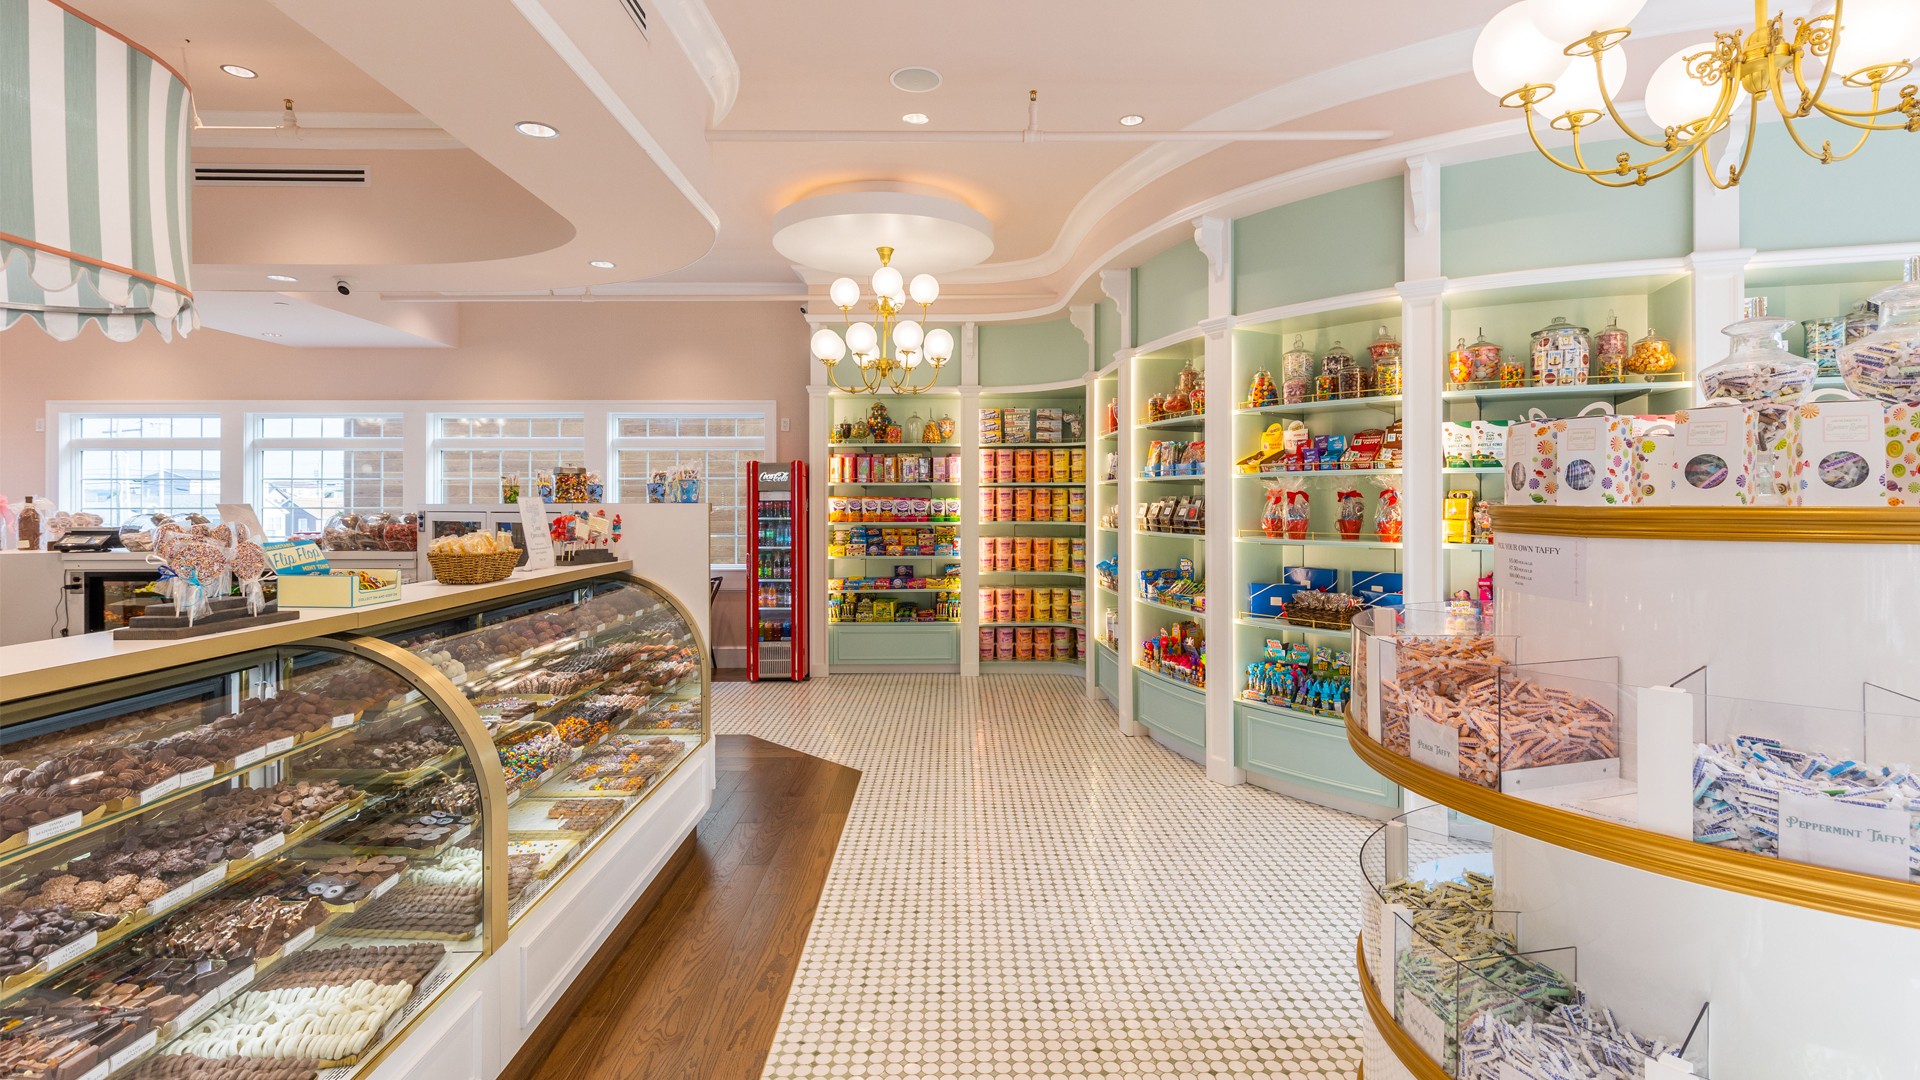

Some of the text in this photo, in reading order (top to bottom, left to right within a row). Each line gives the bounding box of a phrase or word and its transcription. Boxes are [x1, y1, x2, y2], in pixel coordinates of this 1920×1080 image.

[759, 471, 789, 482] Coca-Cola
[1519, 544, 1533, 553] OWN
[1535, 545, 1561, 555] TAFFY
[272, 544, 321, 571] Flip Flop
[1434, 744, 1451, 758] TAFFY
[1741, 782, 1779, 795] JENKINSO
[1786, 815, 1907, 845] PEPPERMINT TAFFY
